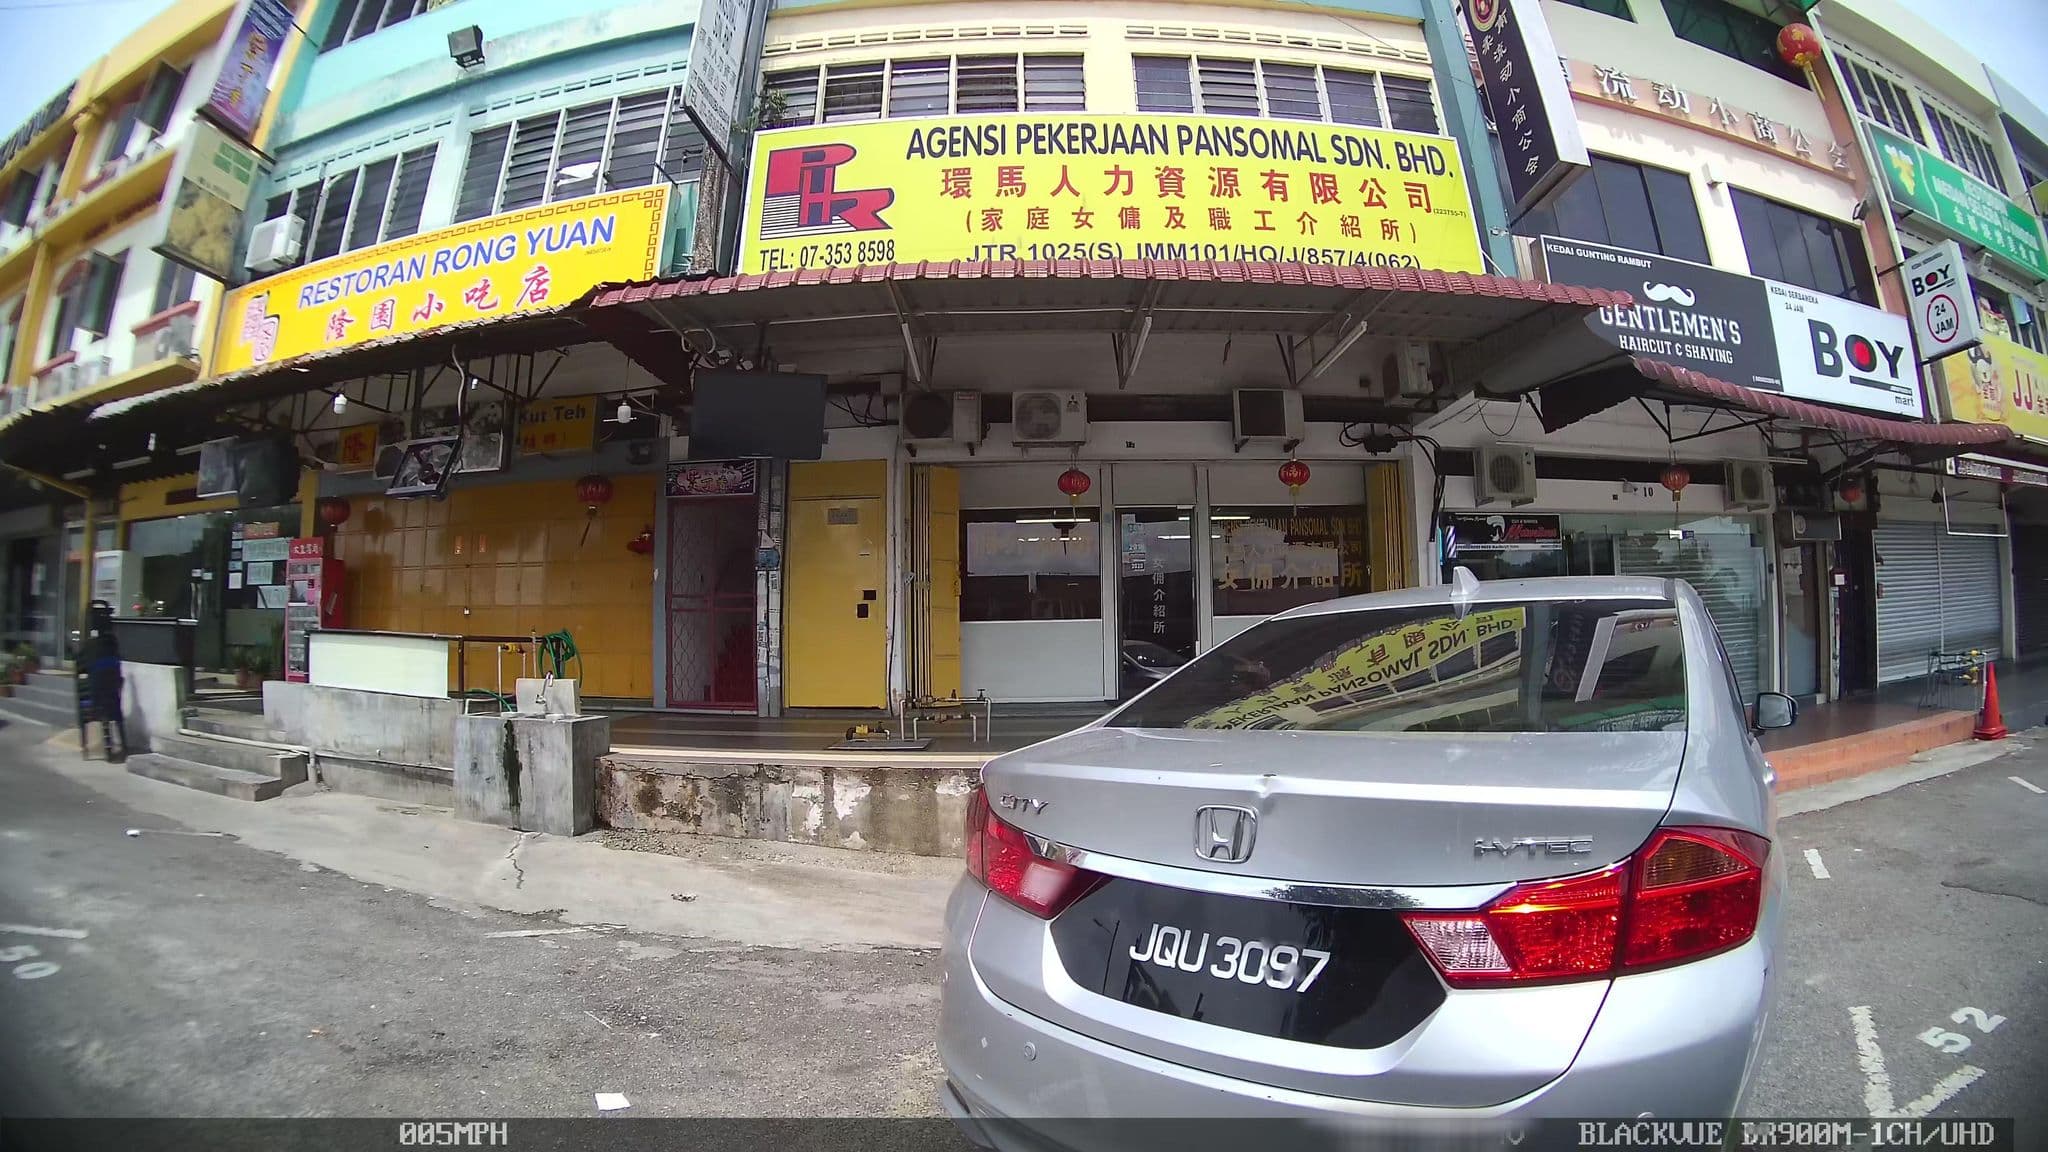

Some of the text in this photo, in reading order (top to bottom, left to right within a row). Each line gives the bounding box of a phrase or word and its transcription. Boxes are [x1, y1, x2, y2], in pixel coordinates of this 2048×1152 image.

[906, 123, 1454, 178] AGENSI PEKERJAAN PANSOMAL SDN. BHD.
[941, 164, 1432, 213] 環馬人力資源有限公司
[299, 216, 614, 309] RESTORAN RONG YUAN
[760, 240, 895, 271] TEL: 07-353 8598
[966, 243, 1016, 263] JTR
[1028, 242, 1122, 261] 1025(S)
[1547, 243, 1652, 269] KEDAI GUNTING RAMBUT
[1911, 264, 1951, 298] BOY
[1600, 303, 1742, 345] GENTLEMEN'S
[1934, 303, 1947, 317] 24
[1935, 318, 1955, 335] JAM
[1619, 334, 1672, 356] HAIRCUT
[1685, 343, 1733, 364] SHAVING
[1807, 318, 1904, 379] BOY
[553, 405, 586, 421] Teh
[1894, 395, 1915, 408] mart
[1643, 487, 1654, 497] 10
[1000, 794, 1049, 814] CITY
[1129, 923, 1331, 993] JQU 3097
[1916, 1006, 2007, 1053] 52
